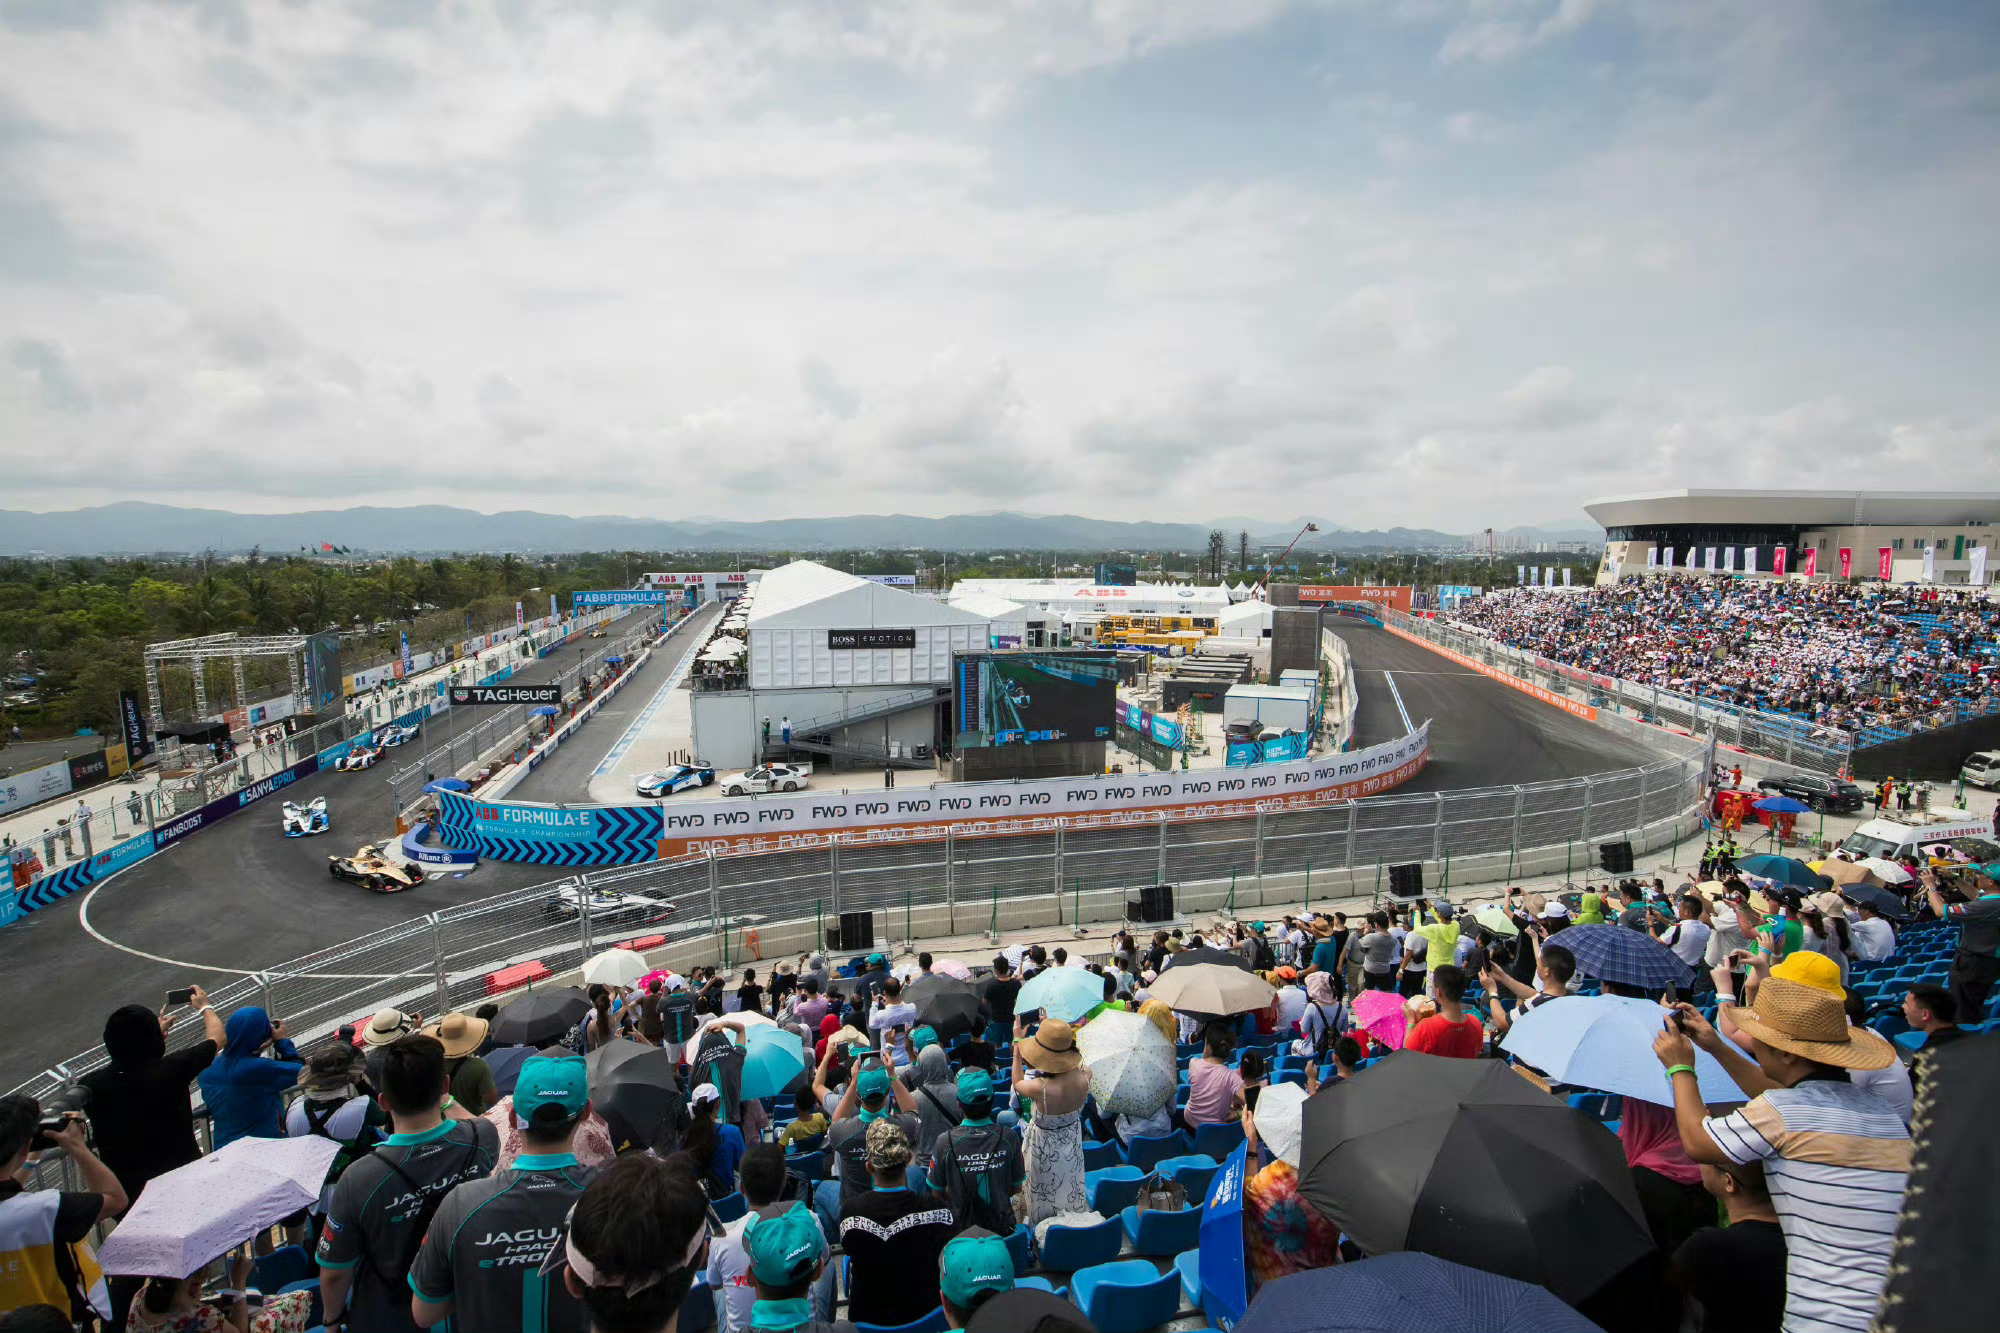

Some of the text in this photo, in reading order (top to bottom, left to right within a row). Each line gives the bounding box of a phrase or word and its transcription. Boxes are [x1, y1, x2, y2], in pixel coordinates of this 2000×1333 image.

[684, 575, 703, 583] ABB
[1361, 589, 1380, 597] FWD
[832, 635, 855, 643] BOSS
[1315, 788, 1338, 803] FWD
[1362, 779, 1380, 793] FWD
[1396, 766, 1408, 780] FWD
[668, 814, 705, 829] FWD
[714, 811, 750, 826] FWD
[758, 808, 794, 823] FWD
[812, 805, 847, 819] FWD
[855, 802, 889, 816] FWD
[898, 800, 931, 813] FWD
[939, 797, 972, 811] FWD
[980, 794, 1011, 807] FWD
[1019, 792, 1051, 805] FWD
[1067, 789, 1098, 802] FWD
[1105, 787, 1135, 800] FWD
[1142, 784, 1172, 798] FWD
[1183, 781, 1211, 794] FWD
[1217, 779, 1245, 792] FWD
[1251, 775, 1277, 788] FWD
[1285, 772, 1310, 784] FWD
[1314, 767, 1335, 780] FWD
[1339, 763, 1359, 776] FWD
[1361, 758, 1376, 771] FWD
[1378, 753, 1394, 766] FWD
[475, 806, 590, 826] ABB FORMULA-E
[418, 852, 441, 863] Allianz
[474, 1227, 558, 1246] JAGU
[504, 1242, 555, 1254] I-PAC
[785, 1242, 812, 1261] JAGUAR
[972, 1274, 1002, 1282] JAGUAR
